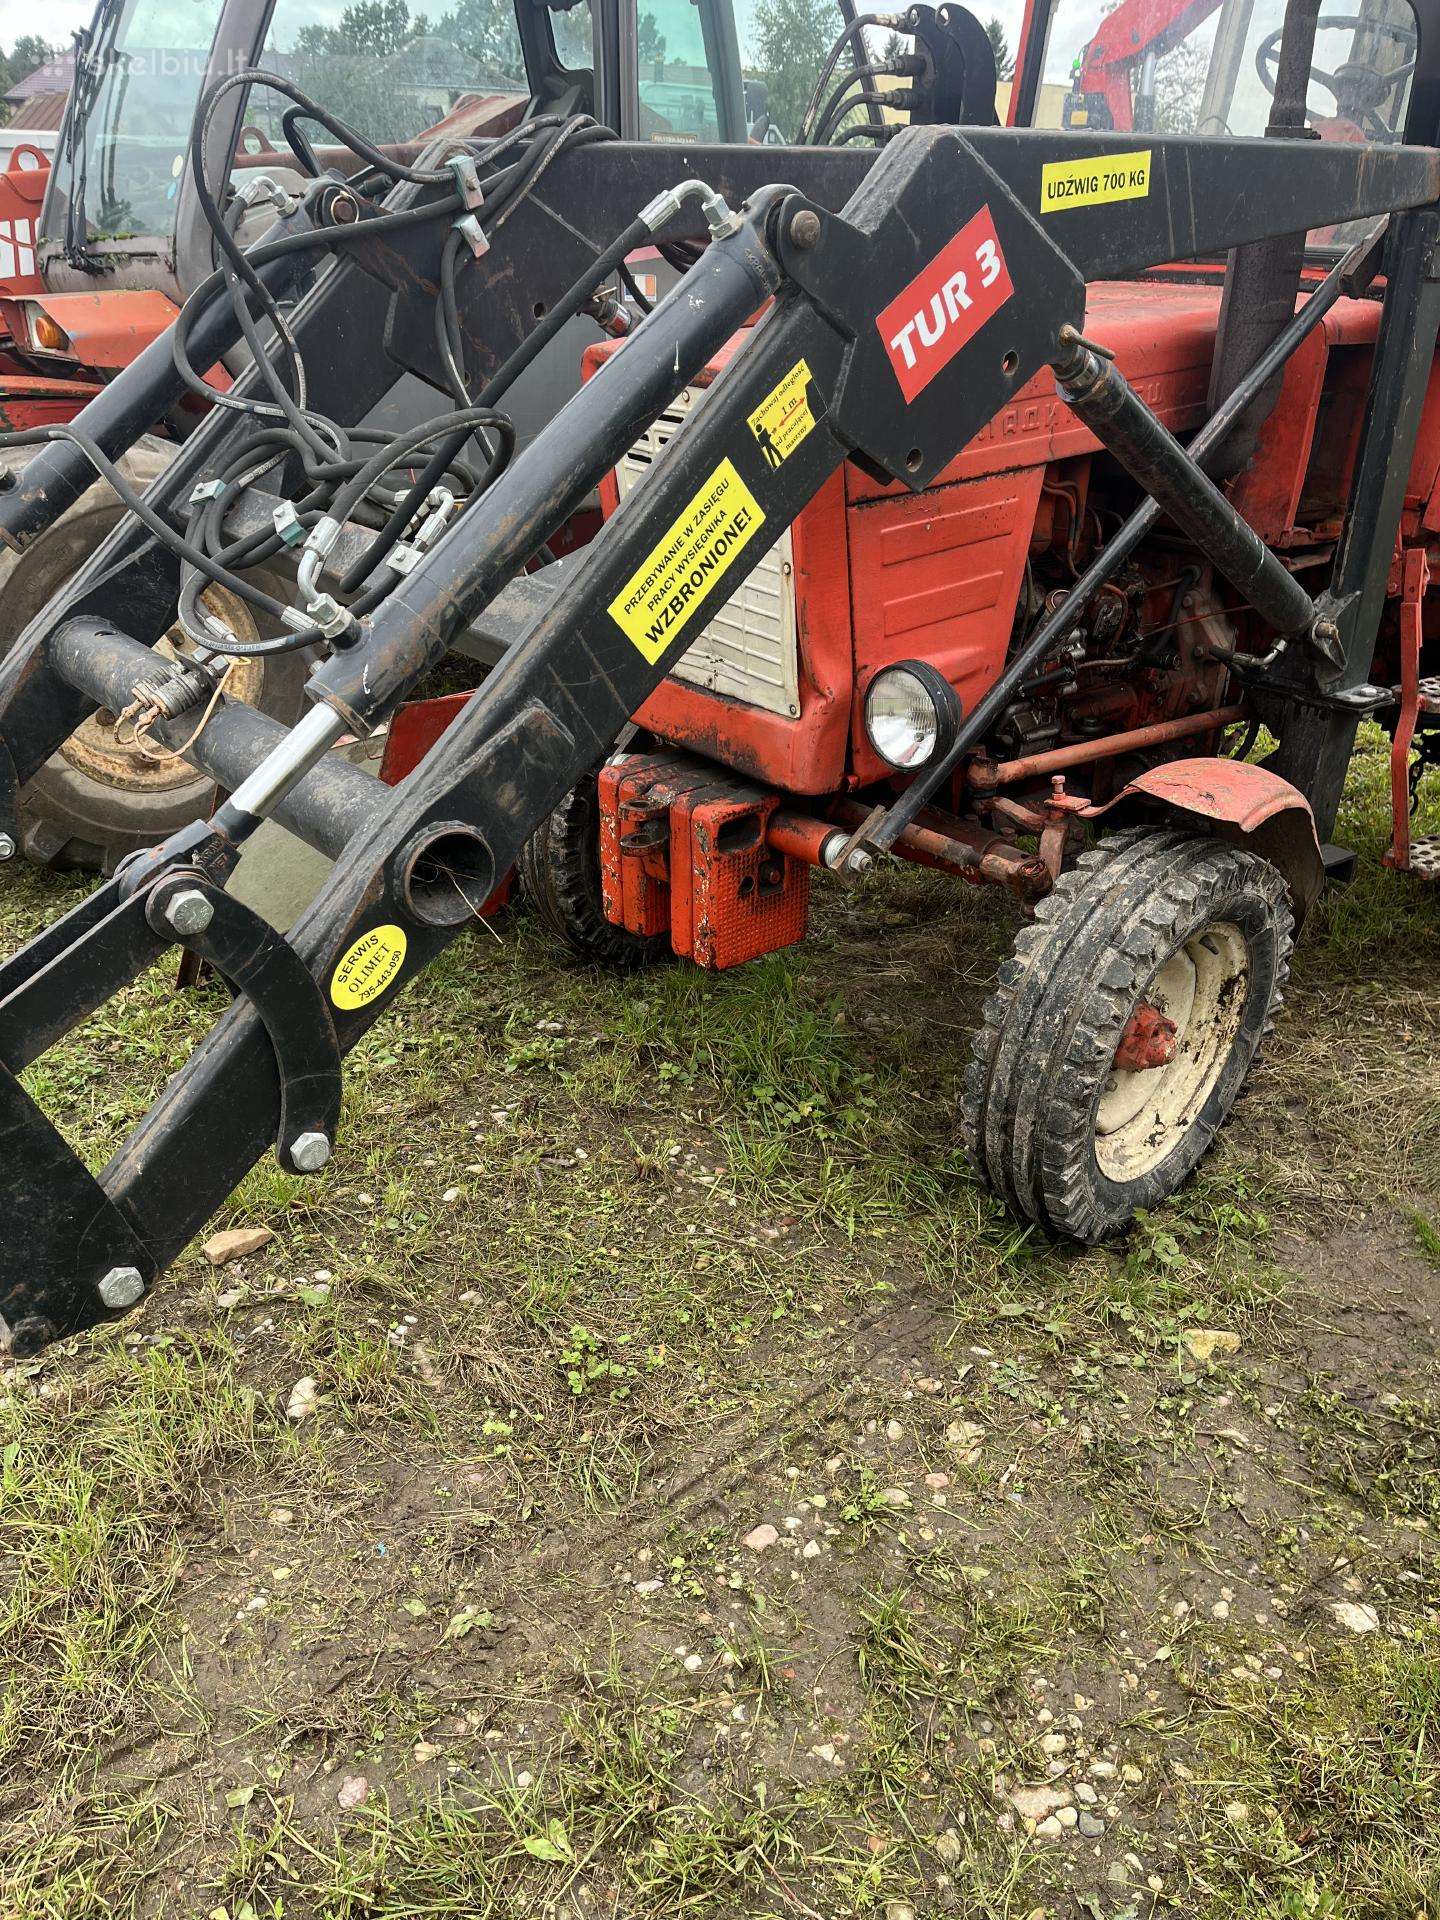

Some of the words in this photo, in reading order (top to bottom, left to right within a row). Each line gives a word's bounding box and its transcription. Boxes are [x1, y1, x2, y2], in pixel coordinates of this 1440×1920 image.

[1047, 174, 1099, 199] UDŹWIG
[1103, 172, 1126, 191] 700
[1129, 169, 1145, 187] KG
[889, 270, 974, 370] TUR
[975, 239, 1001, 289] 3
[750, 395, 779, 427] Zachowaj
[781, 406, 787, 416] 1
[788, 398, 797, 409] m
[775, 436, 783, 447] od
[623, 537, 685, 615] PRZEBYWANIE
[683, 525, 694, 538] W
[692, 478, 730, 527] ZASIĘGU
[646, 573, 677, 612] PRACY
[674, 509, 728, 575] WYSIĘGNIKA
[644, 506, 753, 644] WZBRONIONE!
[337, 934, 379, 983] SERWIS
[348, 943, 391, 993] OLIMET
